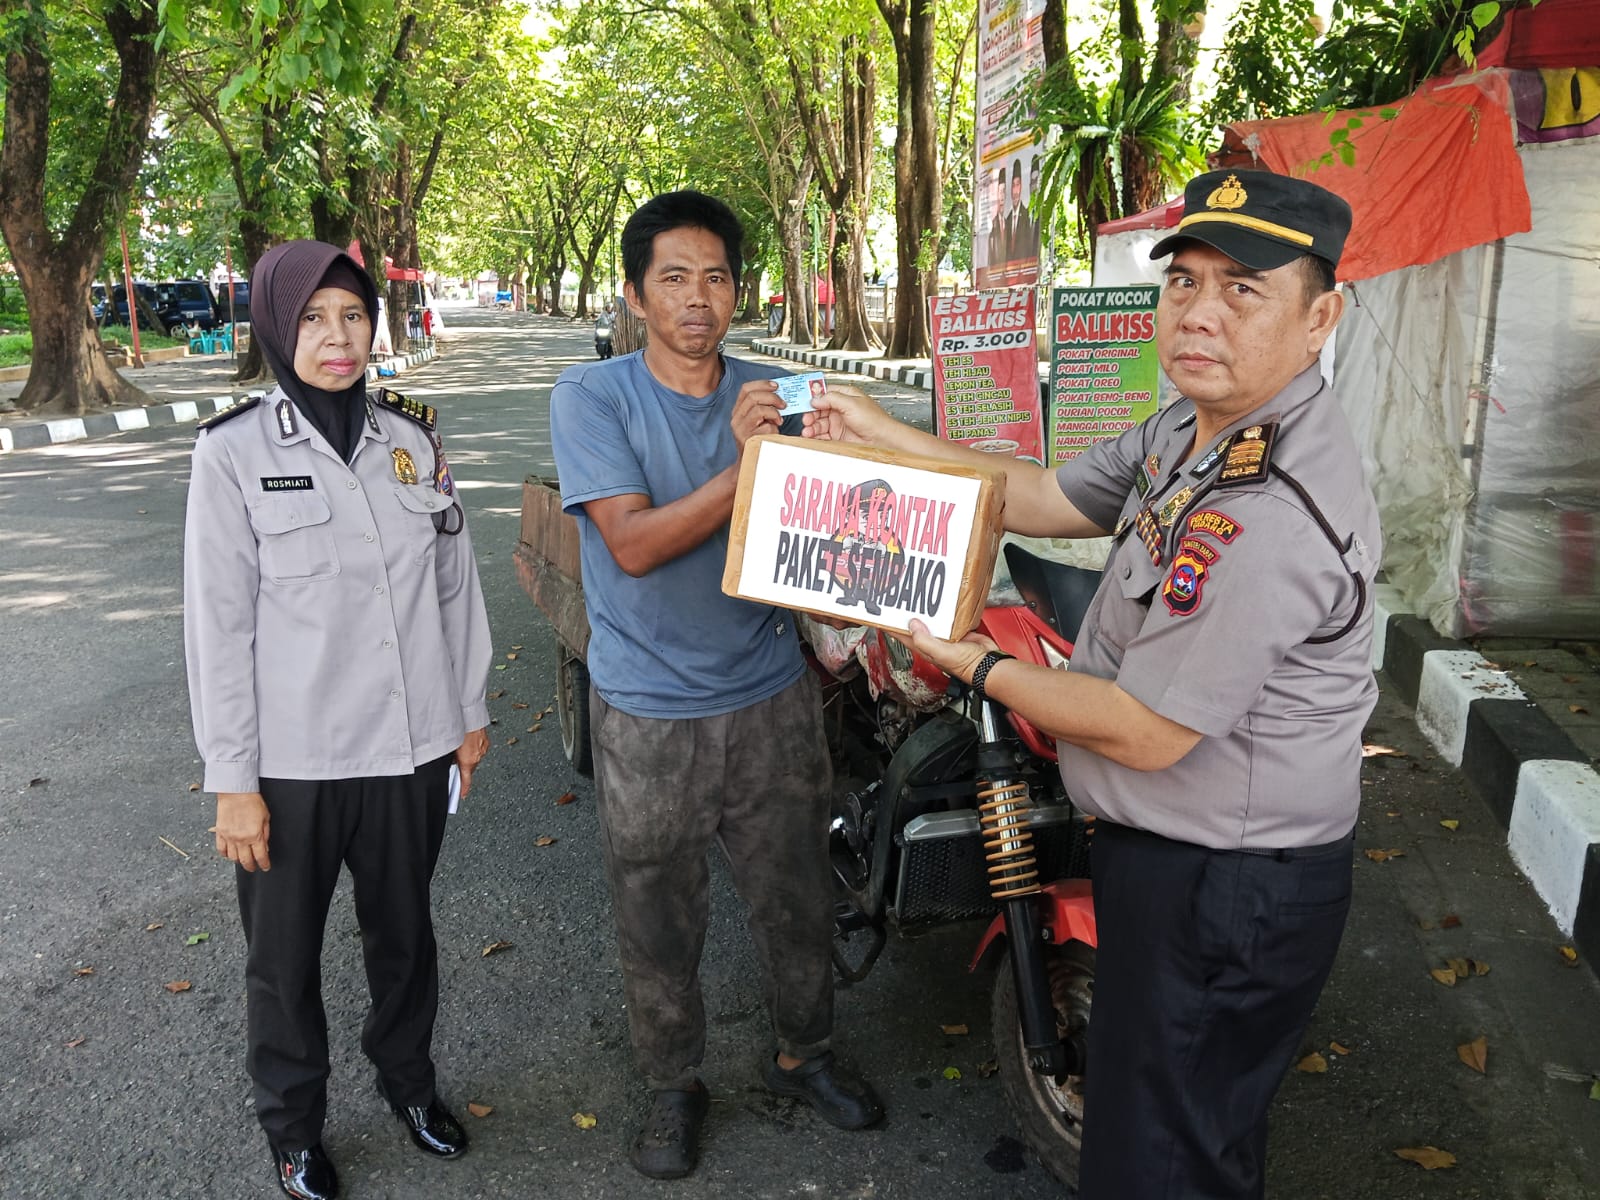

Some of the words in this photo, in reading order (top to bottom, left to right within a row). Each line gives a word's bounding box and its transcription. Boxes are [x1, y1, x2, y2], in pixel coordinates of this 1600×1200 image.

[935, 296, 969, 315] ES
[976, 290, 1030, 311] TEH
[1059, 293, 1104, 307] POKAT
[1105, 291, 1153, 306] KOCOK
[939, 310, 1027, 334] BALLKISS
[1057, 312, 1154, 343] BALLKISS
[941, 339, 969, 352] Rp.
[974, 332, 1027, 348] 3.000
[1058, 350, 1091, 359] POKAT
[1094, 348, 1139, 358] ORIGINAL
[943, 357, 960, 366] TEH
[961, 356, 973, 365] ES
[944, 369, 960, 378] TEH
[962, 367, 989, 377] HIJAU
[1057, 364, 1091, 373] POKAT
[1093, 363, 1118, 373] MILO
[945, 381, 976, 390] LEMON
[978, 379, 994, 388] TEA
[1057, 379, 1091, 388] POKAT
[1093, 378, 1120, 387] OREO
[945, 394, 957, 403] ES
[958, 393, 974, 402] TEH
[1057, 394, 1091, 402] POKAT
[1093, 392, 1150, 402] BENG-BENG
[946, 406, 957, 415] ES
[959, 405, 975, 414] TEH
[976, 402, 1013, 412] SELASIH
[1057, 408, 1094, 417] DURIAN
[1097, 407, 1131, 417] POCOK
[947, 418, 958, 427] ES
[960, 417, 976, 426] TEH
[978, 414, 1006, 425] JERUK
[1007, 412, 1031, 422] NIPIS
[1056, 422, 1098, 431] MANGGA
[1101, 421, 1135, 431] KOCOK
[948, 430, 965, 439] TEH
[966, 428, 996, 438] PANAS
[1056, 436, 1090, 446] NANAS
[267, 479, 308, 488] ROSMIATI
[780, 473, 861, 539] SARANA
[866, 487, 956, 557] KONTAK
[1190, 512, 1234, 534] POLRESTA
[773, 530, 843, 594] PAKET
[847, 542, 946, 618] SEMBAKO
